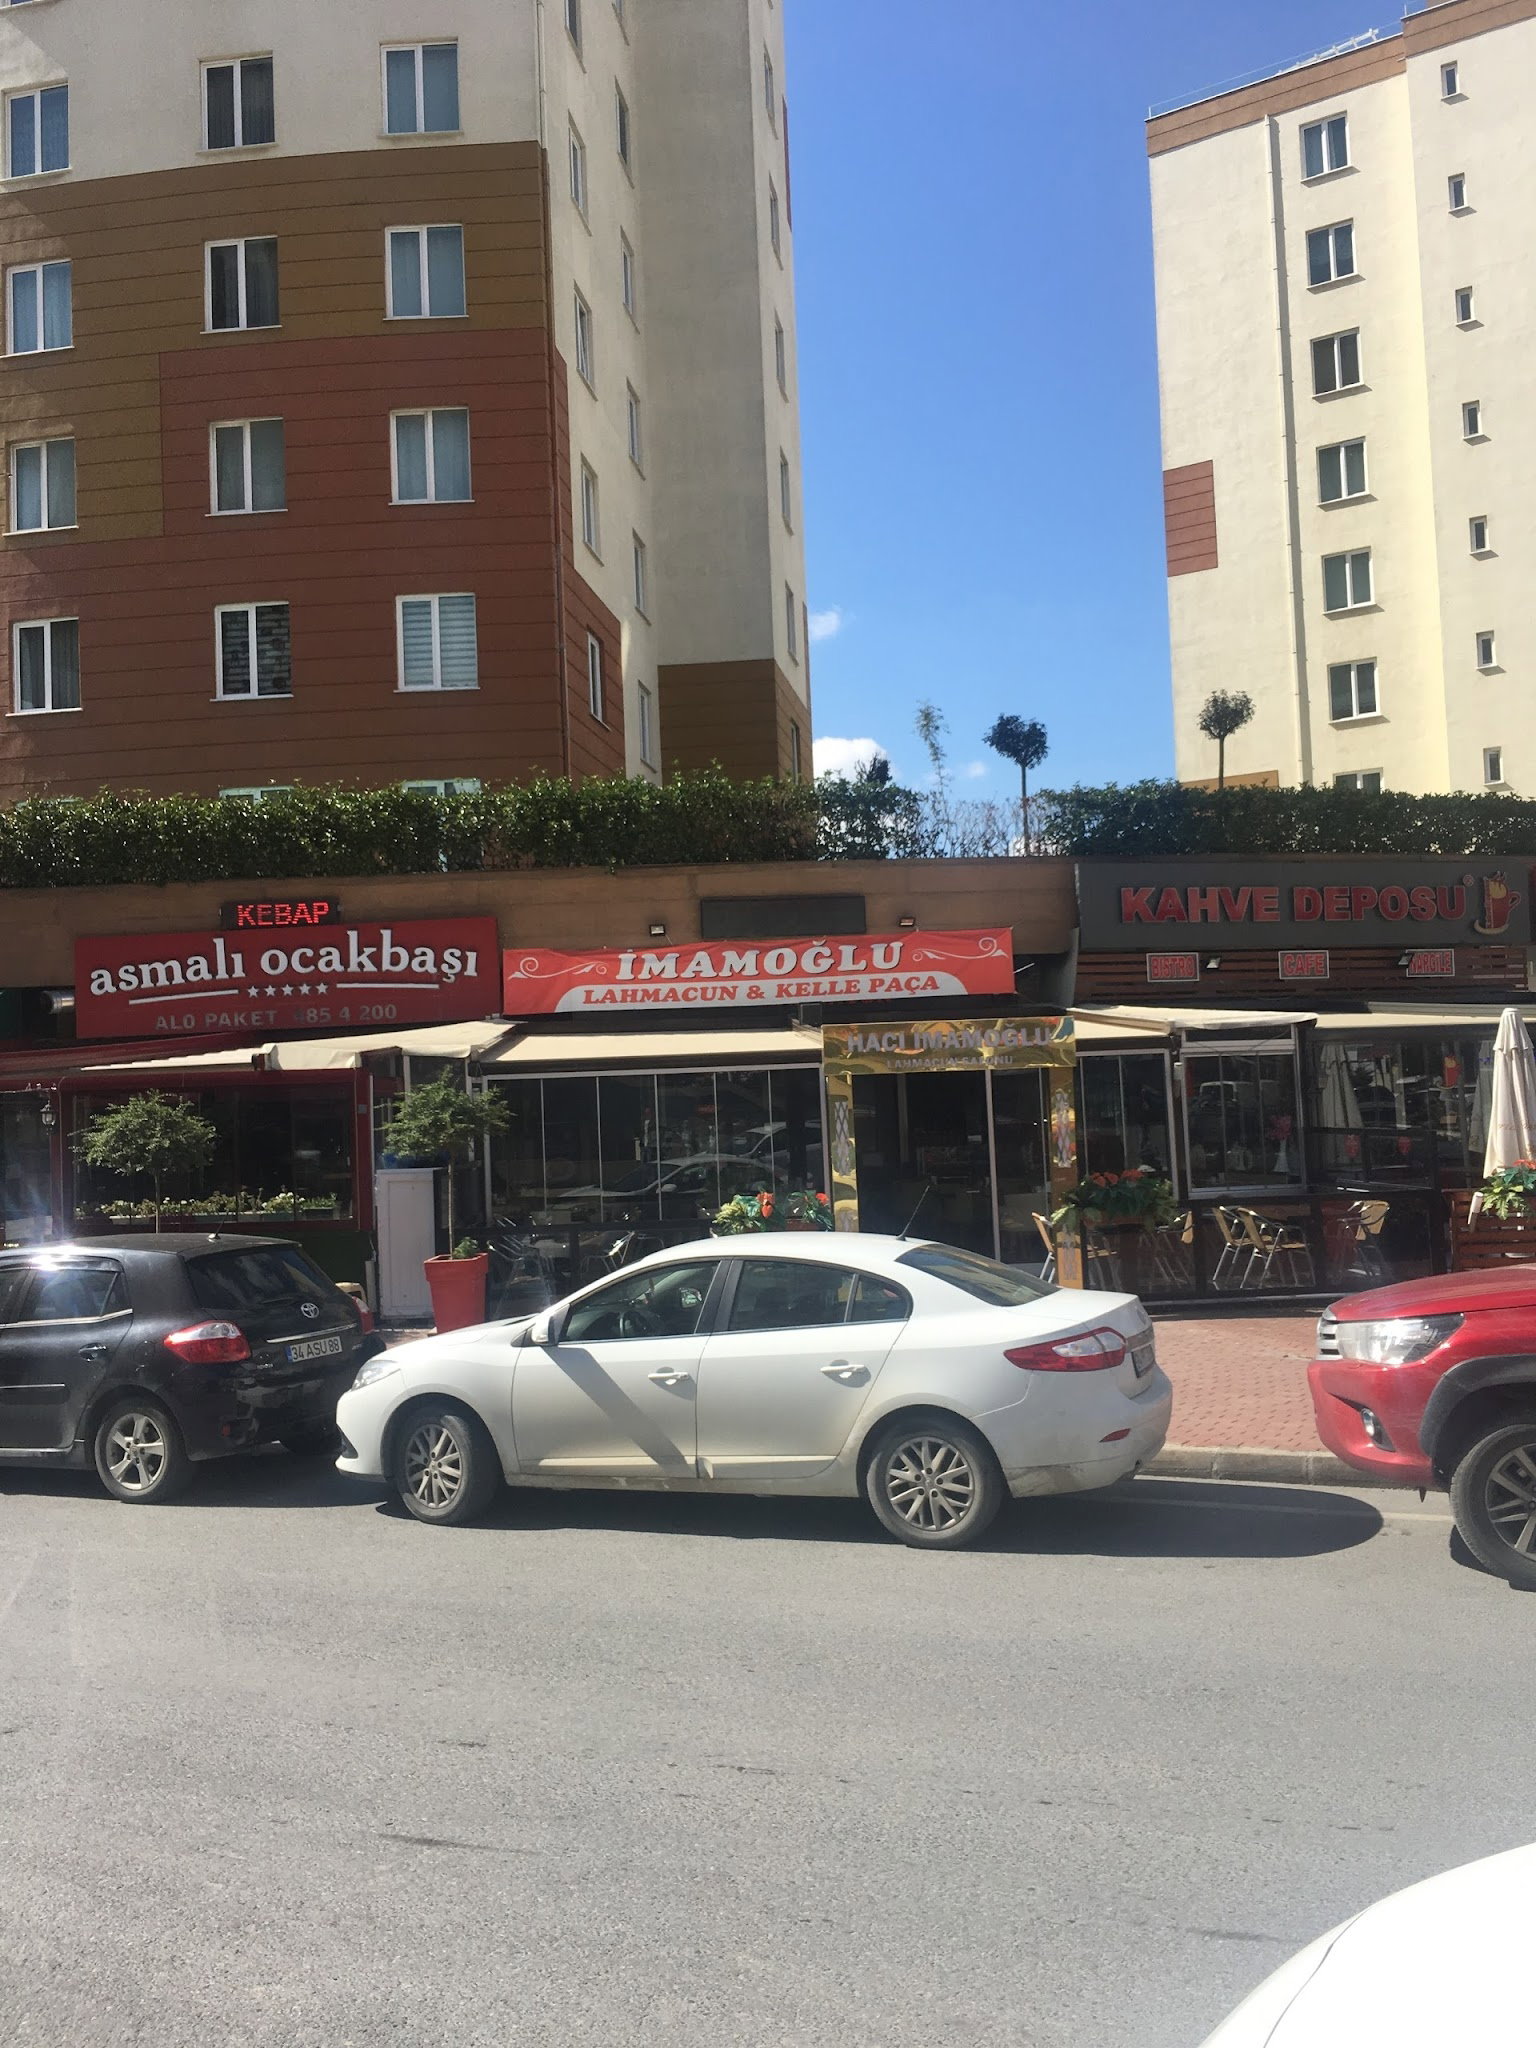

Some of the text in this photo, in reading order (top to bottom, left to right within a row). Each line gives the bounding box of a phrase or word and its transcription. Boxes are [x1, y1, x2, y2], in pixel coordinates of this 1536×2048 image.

[236, 902, 330, 926] KEBAP
[1121, 885, 1467, 923] KAHVE DEPOSU
[90, 929, 478, 996] asmalı ocakbaşı
[615, 940, 904, 981] İMAMOĞLU
[1283, 953, 1325, 976] CAFE
[583, 975, 940, 1005] LAHMACUN & KELLE PAÇA
[155, 1013, 196, 1031] ALO
[204, 1010, 278, 1028] PAKET
[359, 1003, 398, 1021] 200
[847, 1030, 905, 1053] HACI
[291, 1345, 305, 1360] 34
[306, 1340, 327, 1358] ASU
